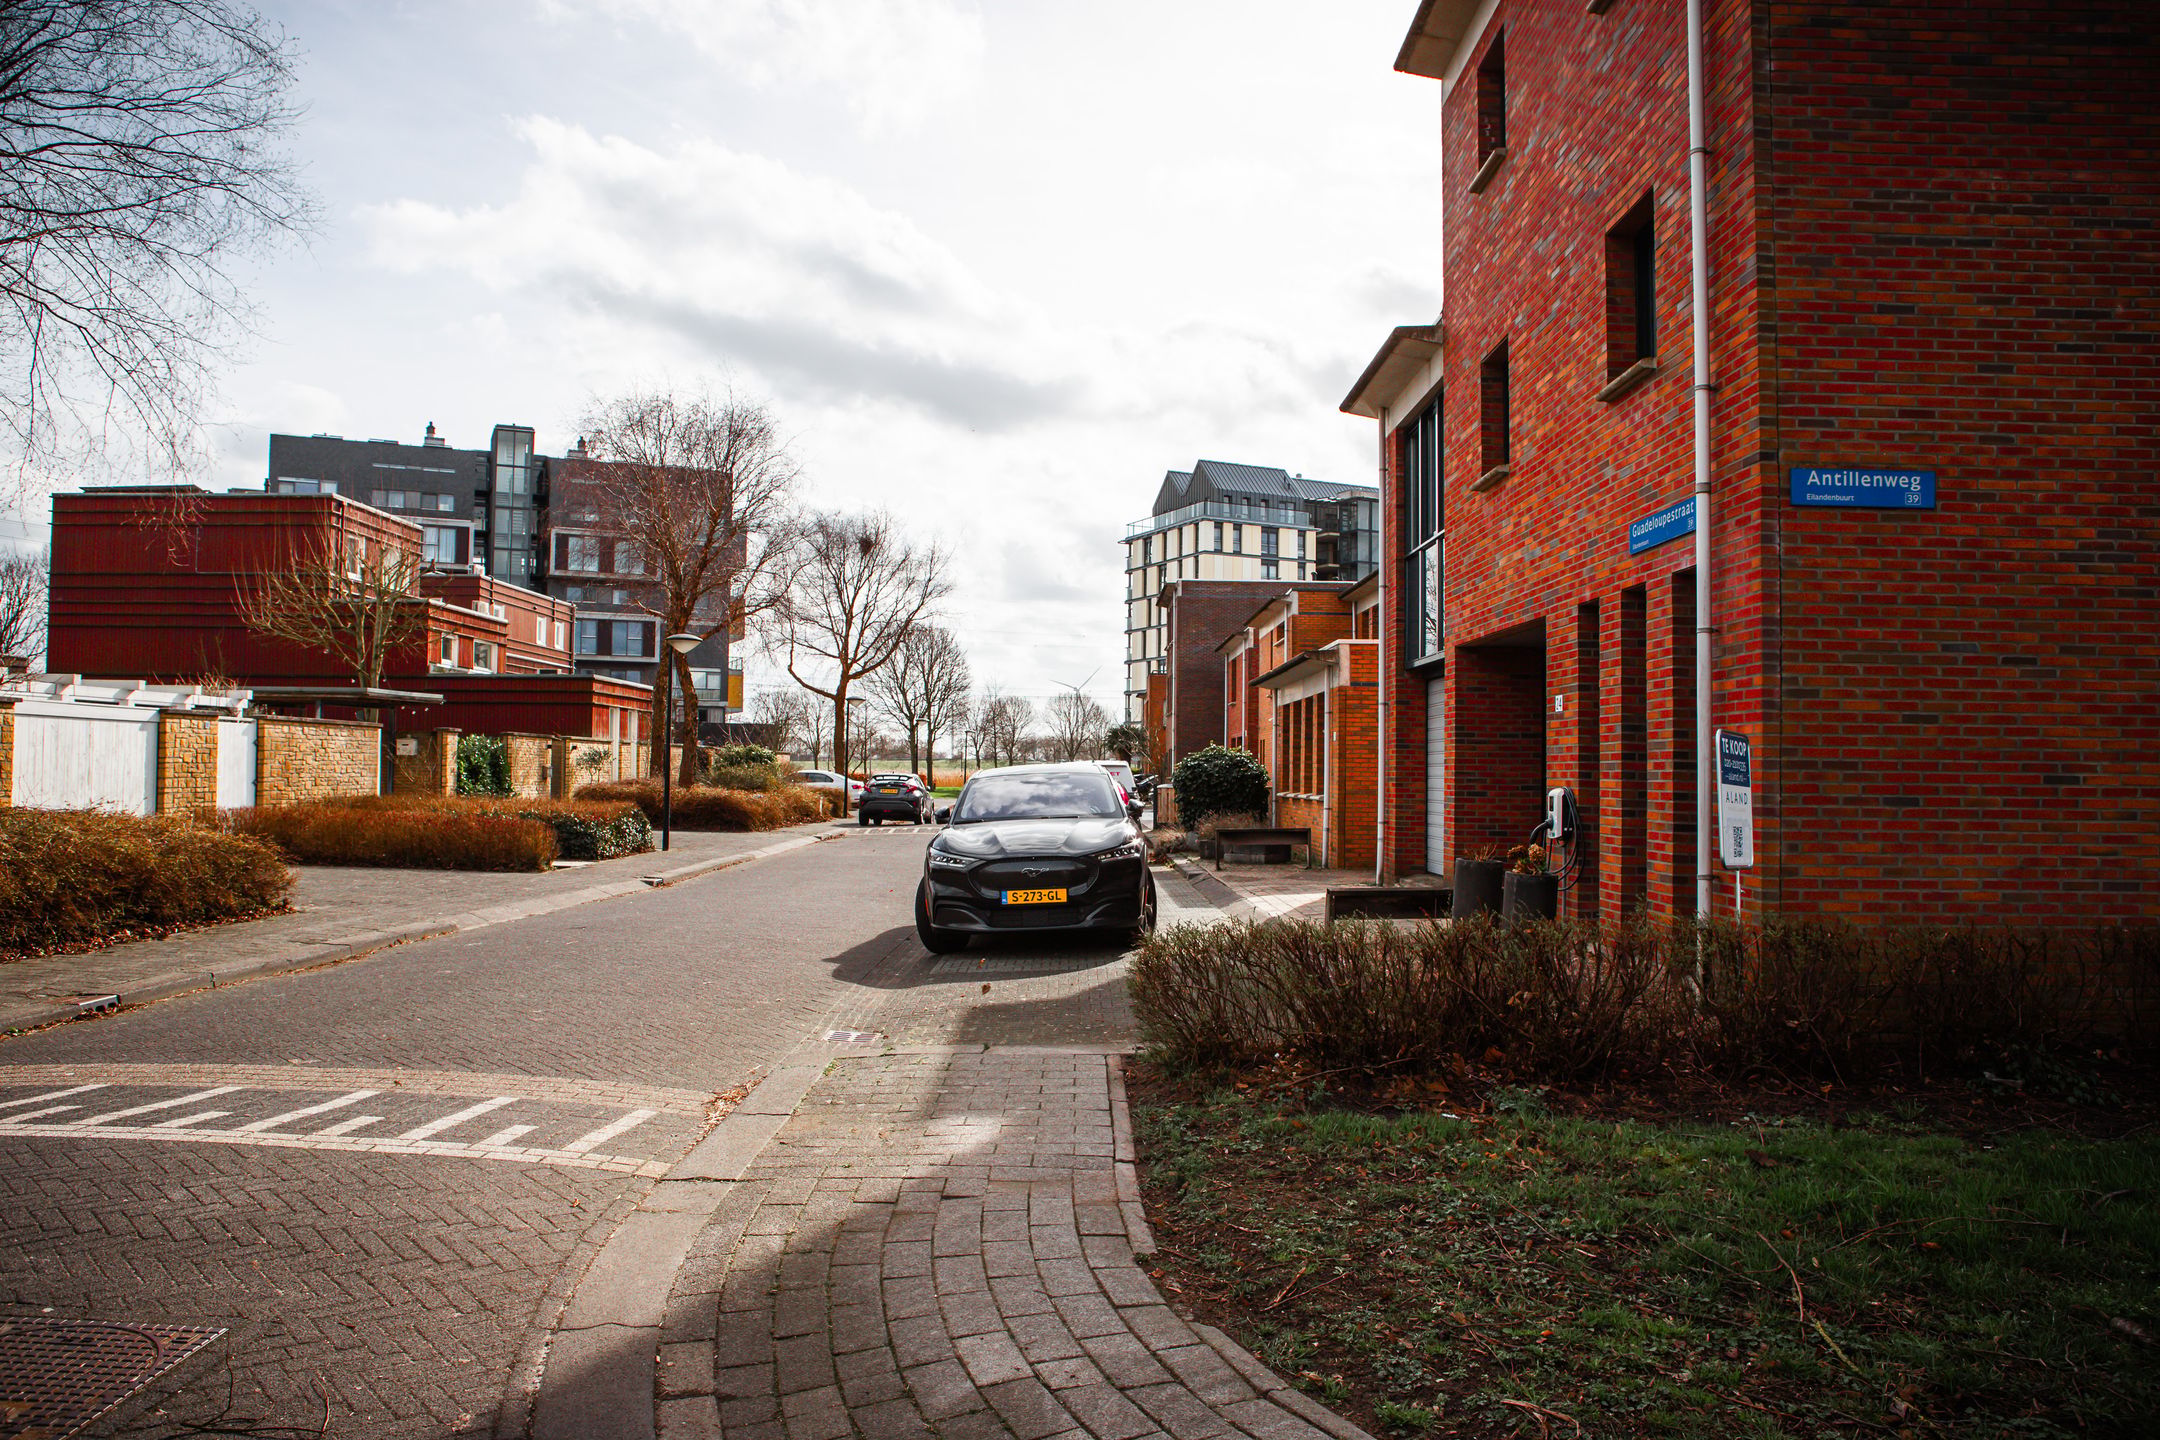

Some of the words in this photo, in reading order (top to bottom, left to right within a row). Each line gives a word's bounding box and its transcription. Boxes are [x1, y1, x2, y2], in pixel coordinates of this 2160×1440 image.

[1807, 470, 1921, 491] Antillenweg
[1806, 493, 1855, 502] Eilandenbuurt
[1907, 494, 1920, 504] 39
[1632, 501, 1695, 538] Guadeloupestraat
[1722, 737, 1729, 753] TE
[1730, 739, 1746, 757] KOOP
[1726, 791, 1748, 805] ALAND
[1012, 890, 1061, 902] S-273-GL
